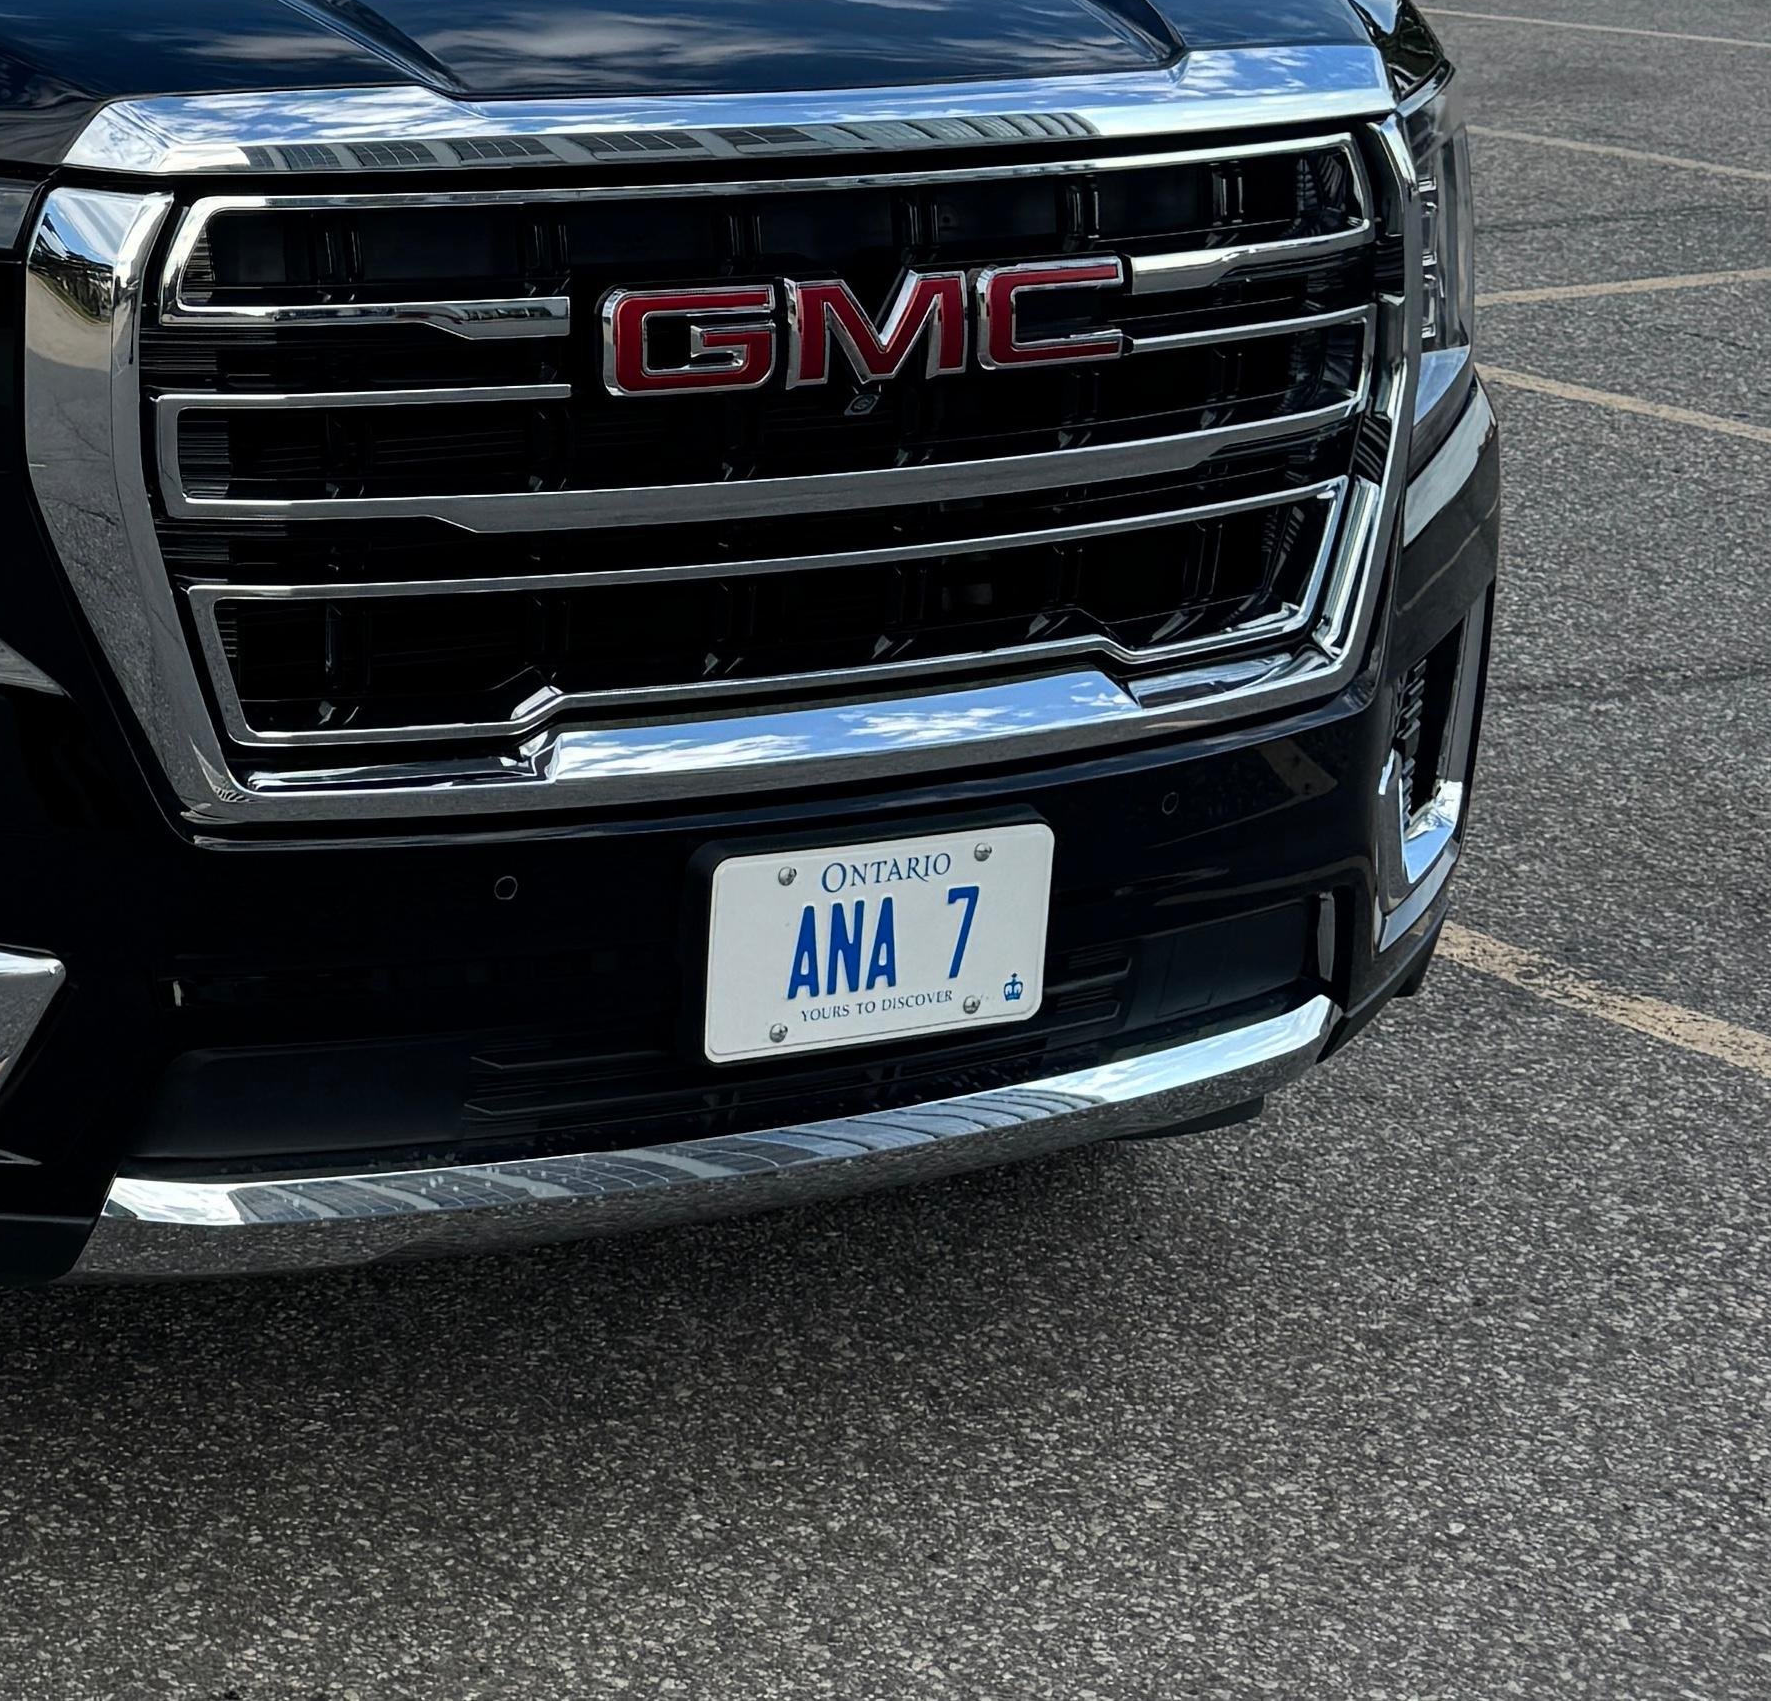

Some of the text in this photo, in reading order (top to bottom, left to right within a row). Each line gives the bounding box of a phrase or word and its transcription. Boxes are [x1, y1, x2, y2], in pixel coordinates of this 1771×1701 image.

[603, 256, 1123, 396] GMC
[821, 853, 951, 893] ONTARIO
[787, 885, 979, 999] ANA 7
[801, 990, 953, 1022] YOURS TO DISCOVER
